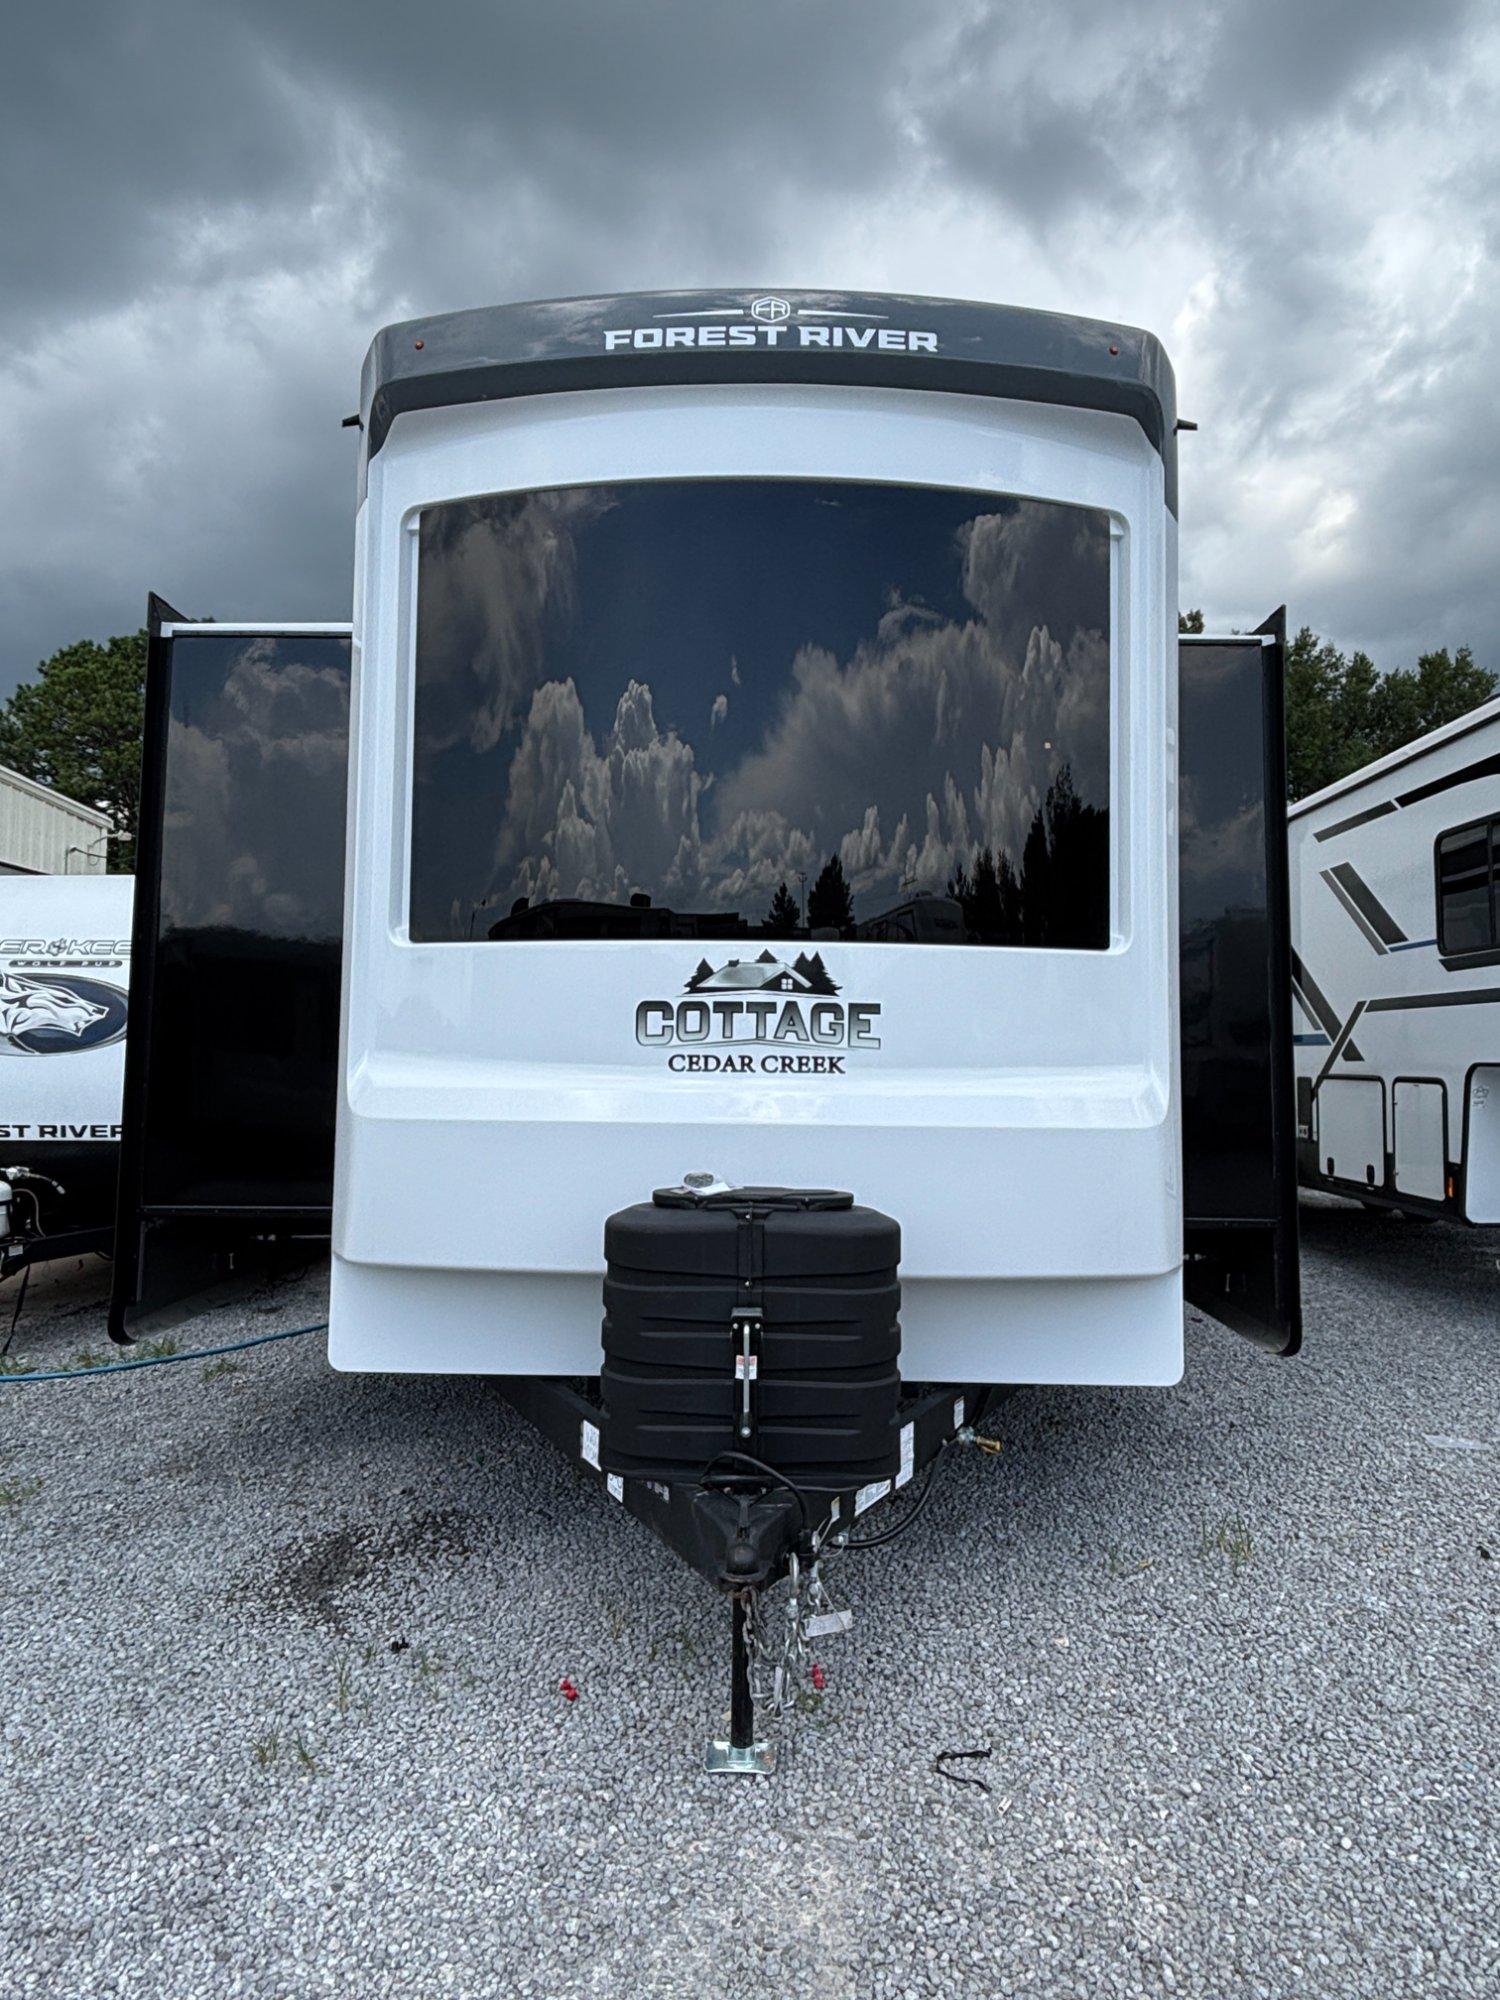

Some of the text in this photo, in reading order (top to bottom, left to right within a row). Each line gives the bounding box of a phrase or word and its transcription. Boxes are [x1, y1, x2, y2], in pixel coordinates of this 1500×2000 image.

[603, 325, 938, 352] FOREST RIVER
[635, 1000, 881, 1050] COTTAGE
[668, 1053, 846, 1074] CEDAR CREEK
